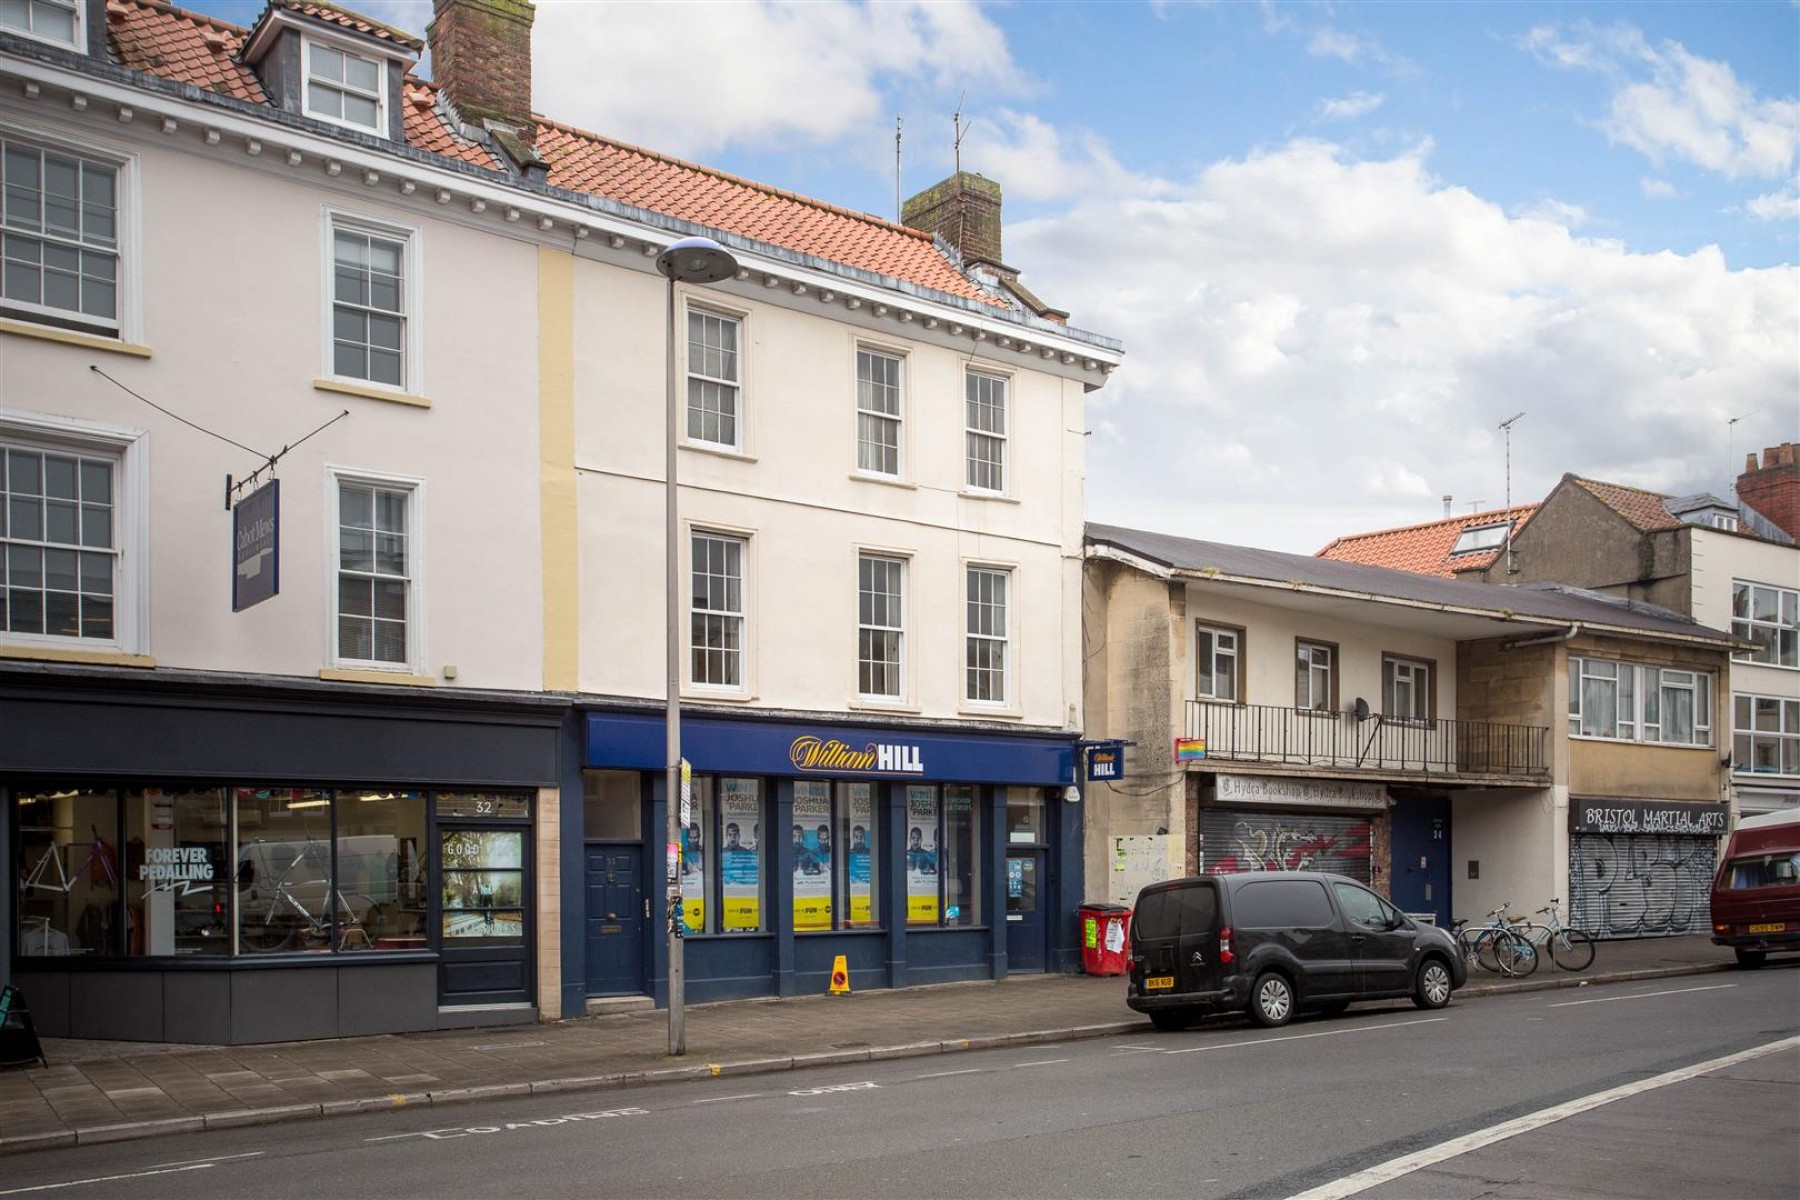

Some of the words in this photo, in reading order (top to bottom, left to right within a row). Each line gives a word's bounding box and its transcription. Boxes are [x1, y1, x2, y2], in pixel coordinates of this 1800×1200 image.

[789, 735, 878, 772] William
[878, 744, 923, 772] HILL
[1094, 762, 1115, 776] HILL
[1233, 780, 1260, 797] Hydra
[1262, 781, 1301, 800] Bookshop
[476, 801, 492, 814] 32
[1586, 807, 1637, 825] BRISTOL
[1643, 808, 1693, 825] MARTIAL
[1699, 812, 1725, 828] ARTS
[145, 847, 207, 863] FOREVER
[140, 864, 214, 880] PEDALLING
